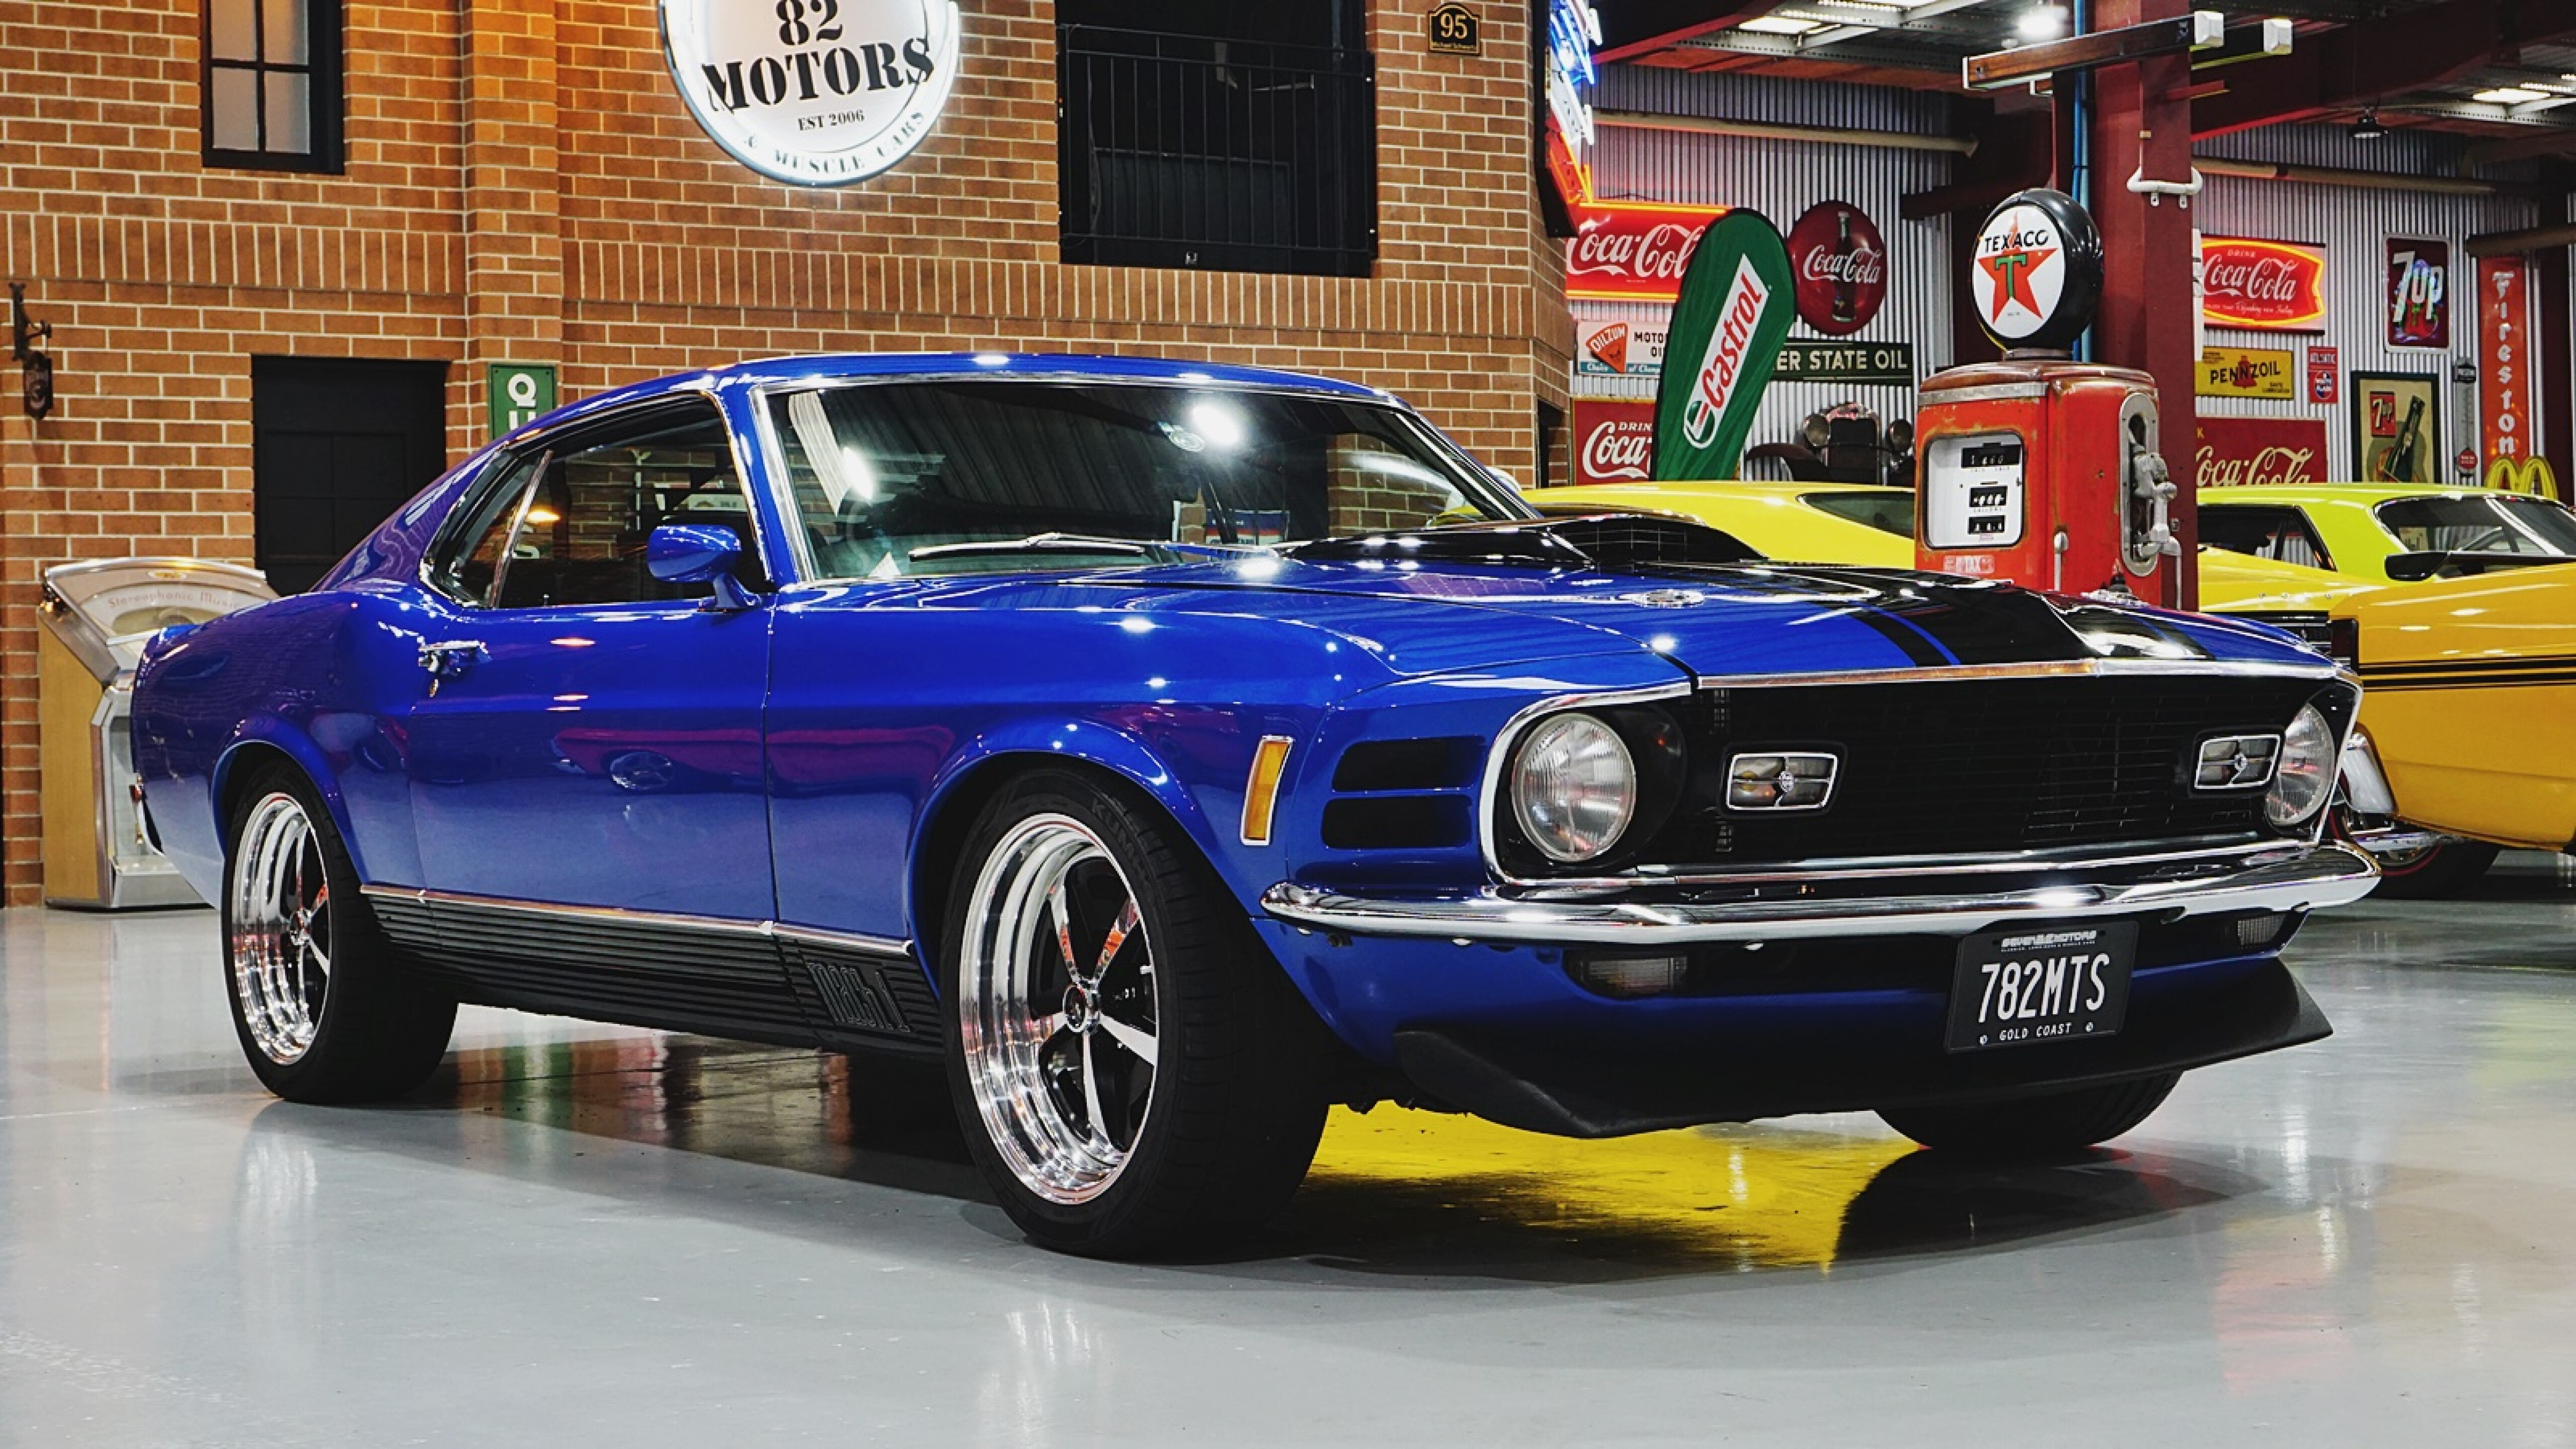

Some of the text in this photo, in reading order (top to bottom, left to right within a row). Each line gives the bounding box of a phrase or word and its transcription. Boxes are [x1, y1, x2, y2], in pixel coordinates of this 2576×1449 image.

[1440, 13, 1468, 39] 95
[702, 37, 935, 113] MOTORS
[797, 109, 865, 131] EST 2006
[1984, 229, 2049, 253] TEXACO
[1803, 244, 1883, 284] Coca-Cola
[1634, 331, 1667, 343] MOTO
[1702, 272, 1762, 409] Castrol
[1650, 346, 1666, 358] OI
[1810, 350, 1868, 370] STATE
[1875, 349, 1908, 369] OIL
[2210, 360, 2282, 385] PENNZOIL
[1618, 421, 1652, 432] DRIN
[1978, 952, 2110, 1023] 782MTS
[1999, 1022, 2073, 1041] GOLD COAST
